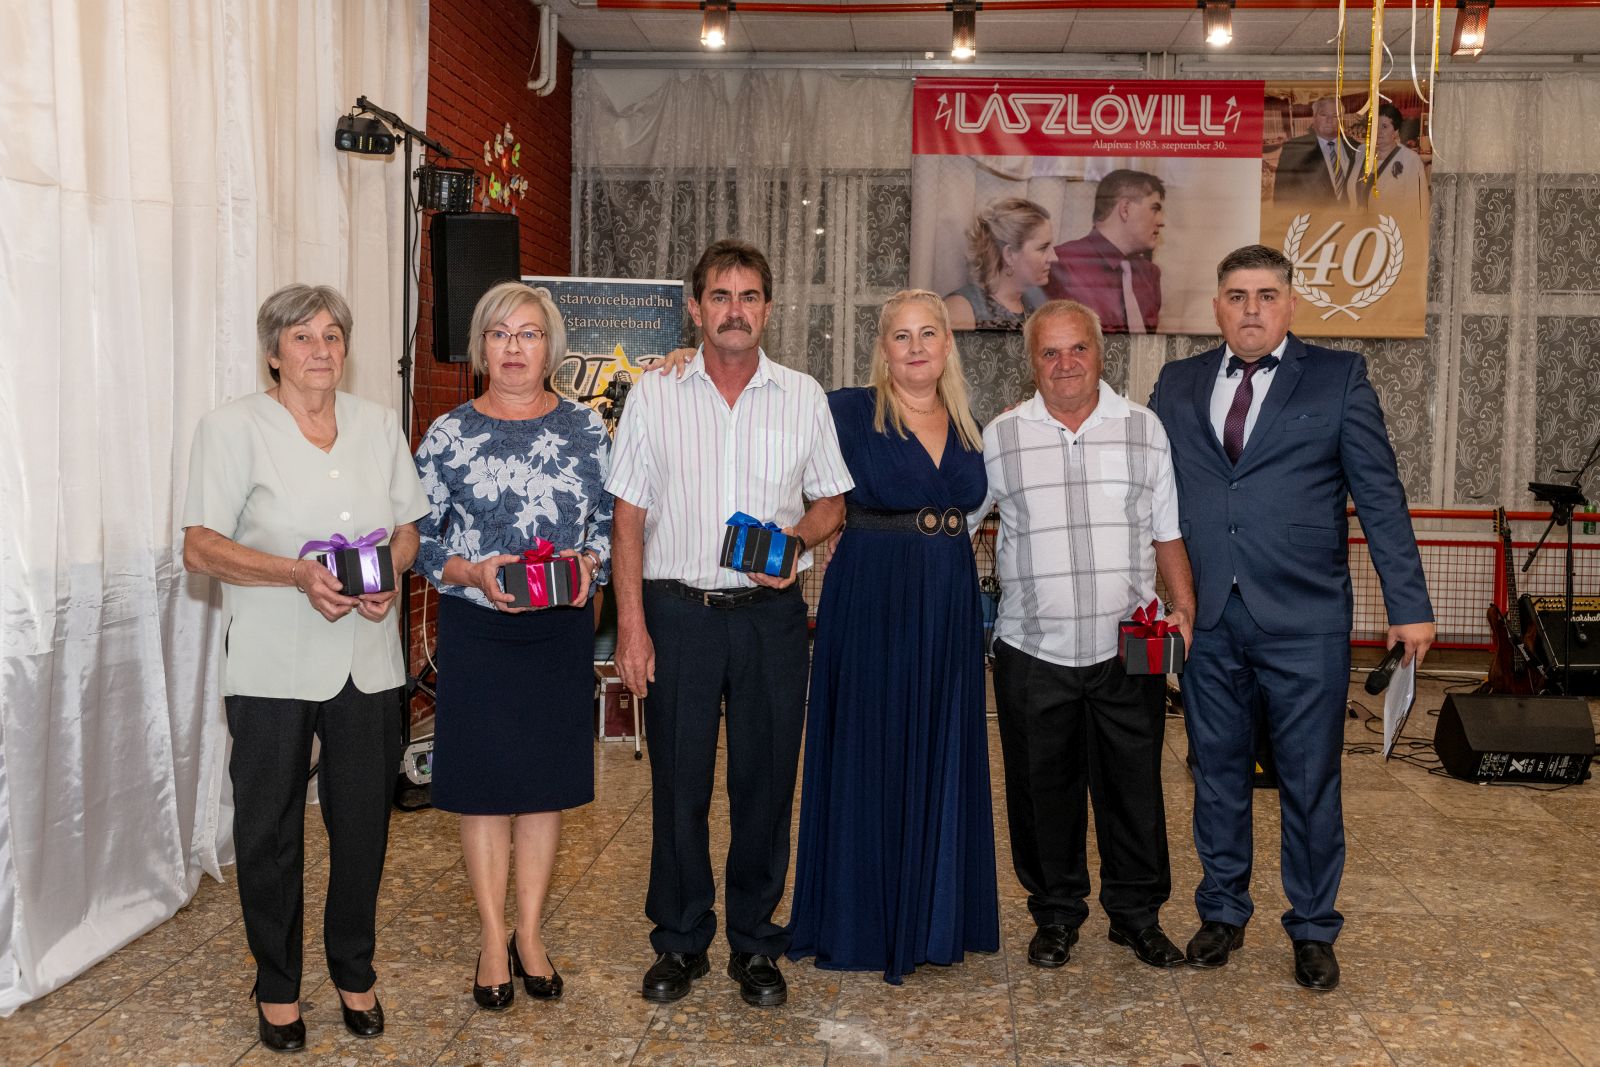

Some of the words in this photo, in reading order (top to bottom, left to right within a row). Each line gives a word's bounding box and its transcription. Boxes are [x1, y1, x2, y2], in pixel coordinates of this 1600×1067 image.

[955, 83, 1226, 135] LÁSZLÓVILL
[1092, 139, 1132, 151] Alapítva:
[1135, 140, 1159, 150] 1983.
[1162, 141, 1211, 152] szeptember
[1213, 141, 1227, 151] 30.
[1294, 221, 1390, 288] 40
[559, 293, 673, 308] starvoiceband.hu
